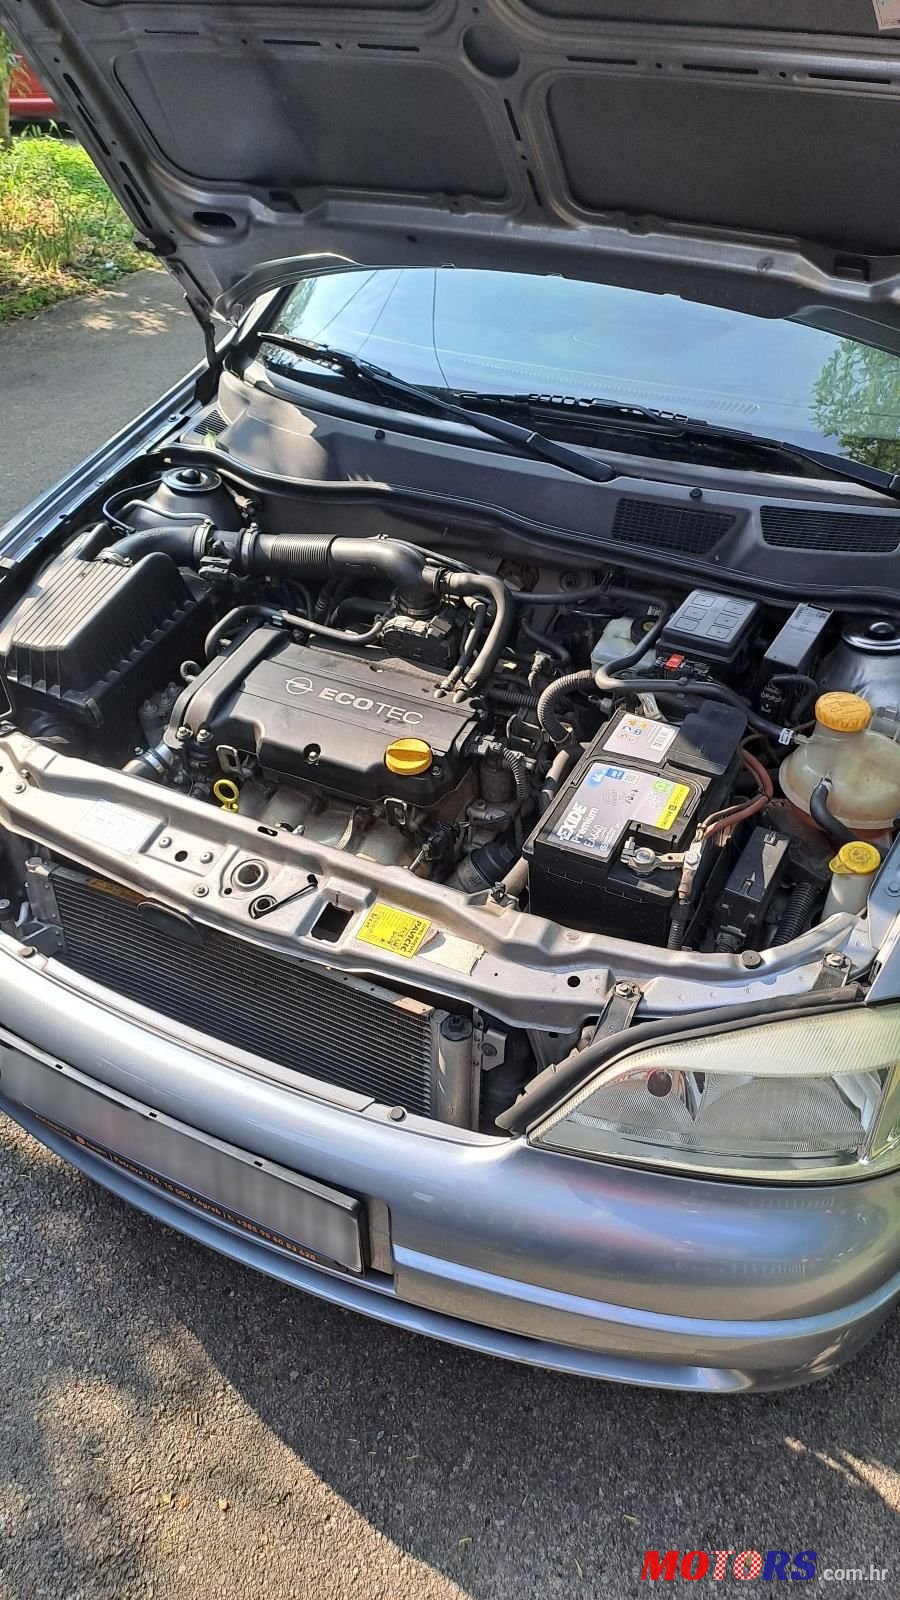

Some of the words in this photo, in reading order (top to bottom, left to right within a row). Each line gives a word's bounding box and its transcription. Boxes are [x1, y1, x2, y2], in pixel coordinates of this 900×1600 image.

[318, 687, 424, 725] ECOTEC
[557, 800, 588, 841] EXIDE
[570, 807, 600, 844] Premium
[583, 824, 605, 848] EA640
[113, 1155, 143, 1176] Petrova
[192, 1196, 221, 1215] Zagreb
